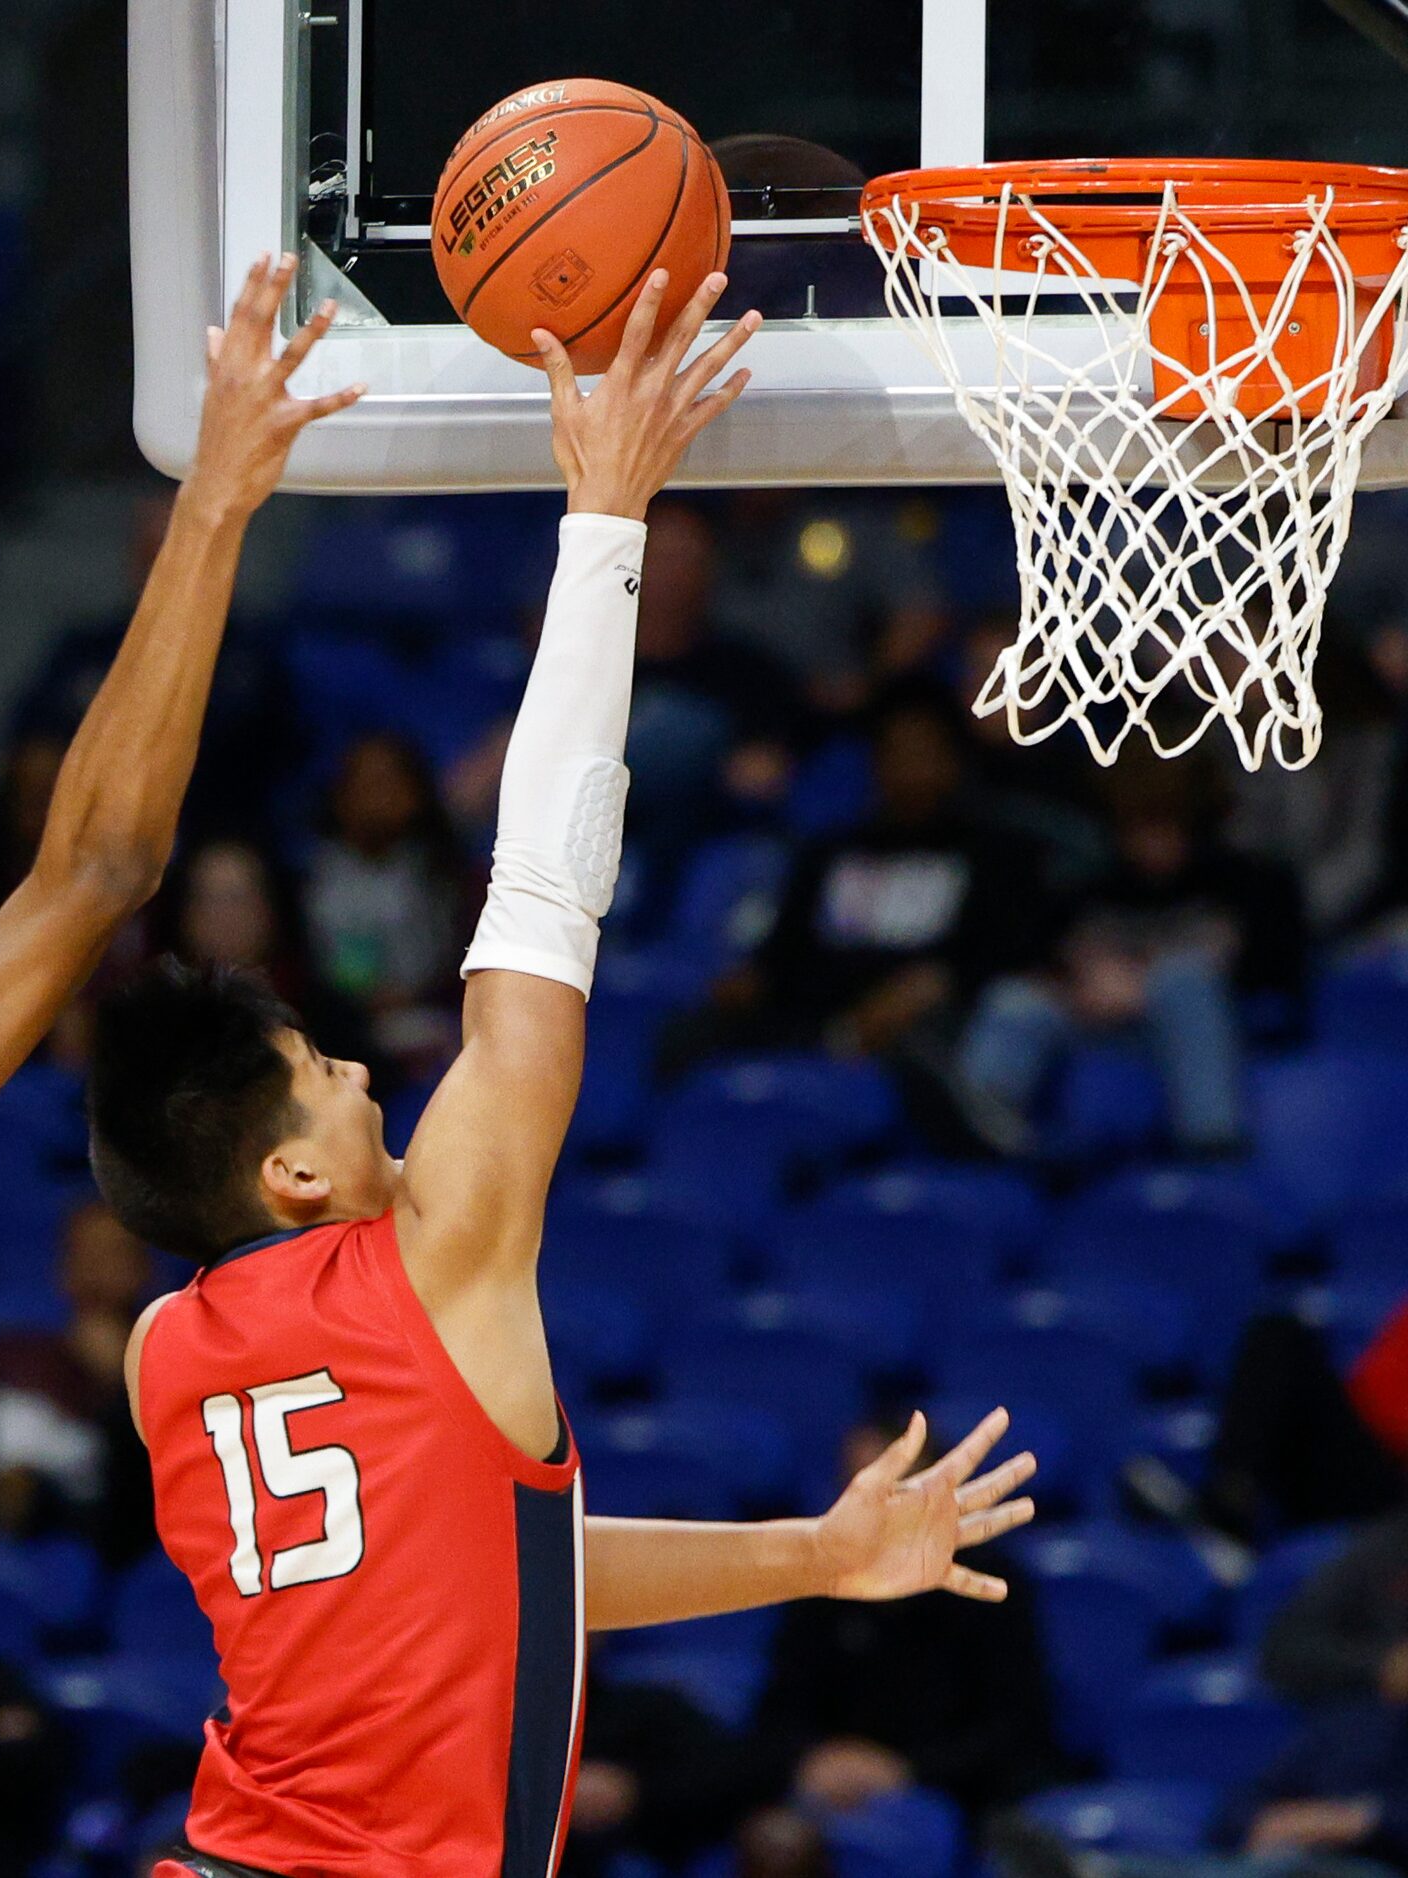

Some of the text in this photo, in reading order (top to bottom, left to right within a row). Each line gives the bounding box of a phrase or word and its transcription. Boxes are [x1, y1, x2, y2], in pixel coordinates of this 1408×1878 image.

[440, 129, 558, 255] LEGACY
[475, 160, 555, 232] 1000
[503, 204, 522, 224] GAME
[200, 1367, 365, 1598] 15
